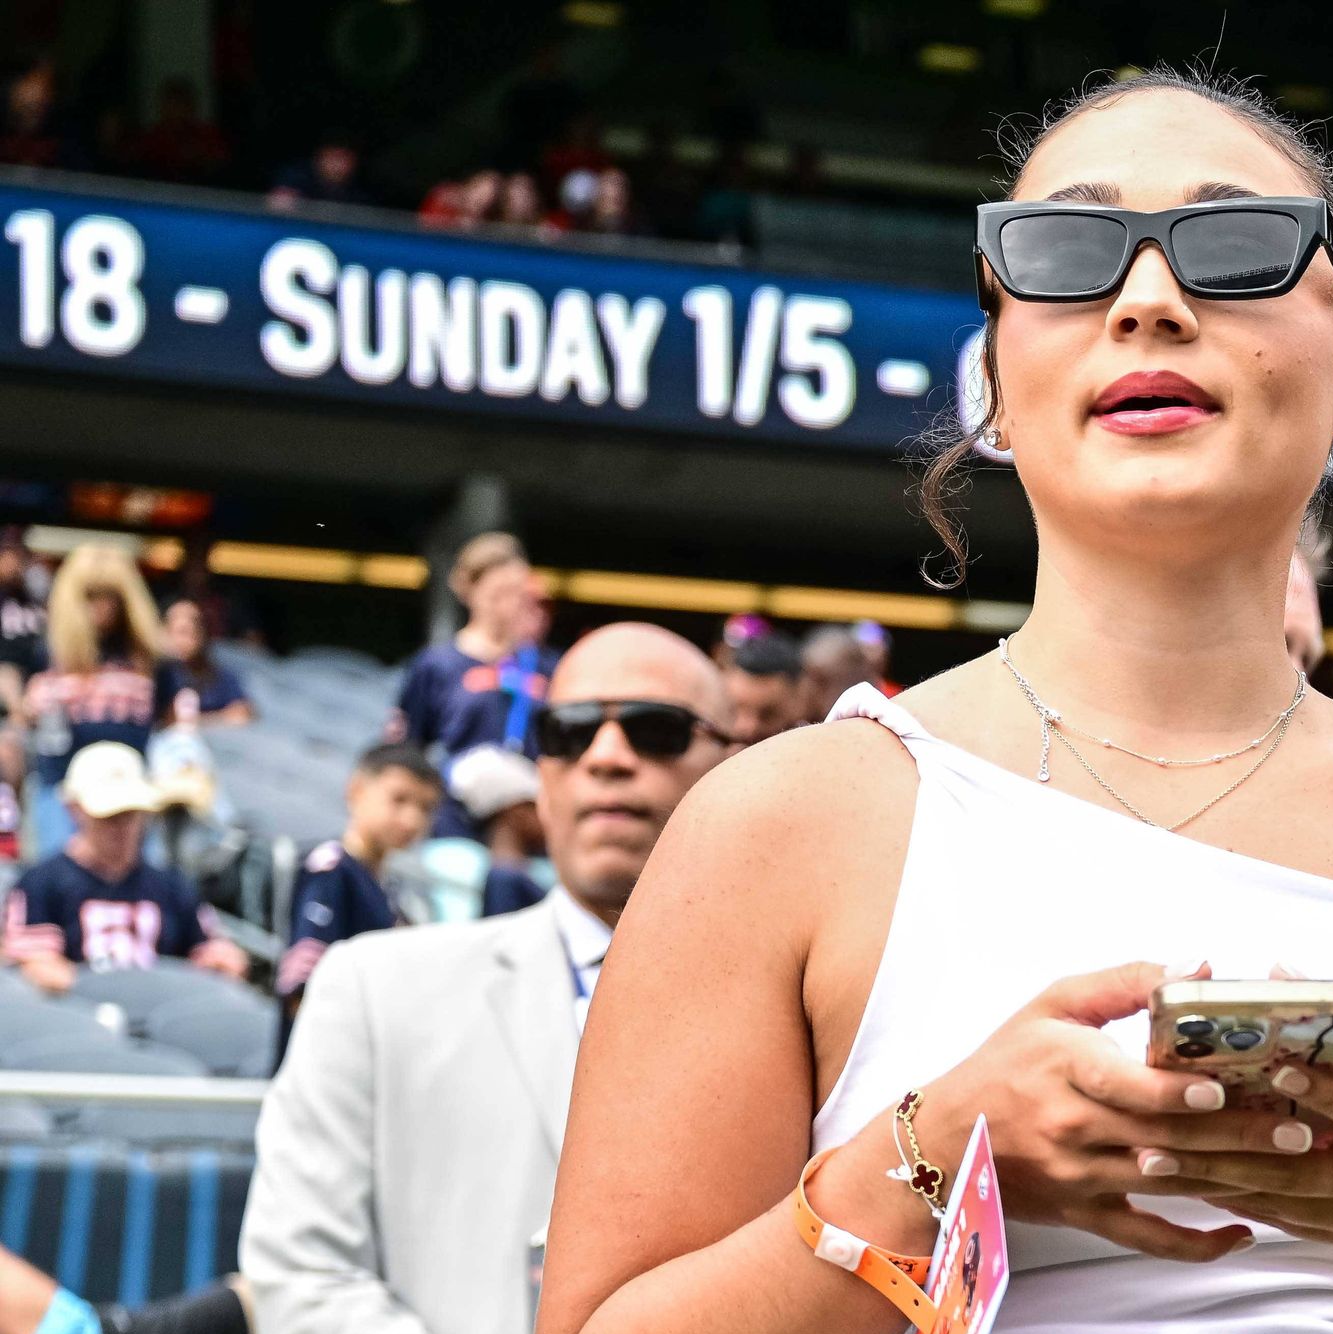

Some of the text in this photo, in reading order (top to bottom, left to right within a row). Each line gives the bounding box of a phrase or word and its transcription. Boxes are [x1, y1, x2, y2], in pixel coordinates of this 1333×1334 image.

[2, 207, 147, 359] 18
[259, 237, 667, 411] SUNDAY
[682, 284, 858, 430] 1/5
